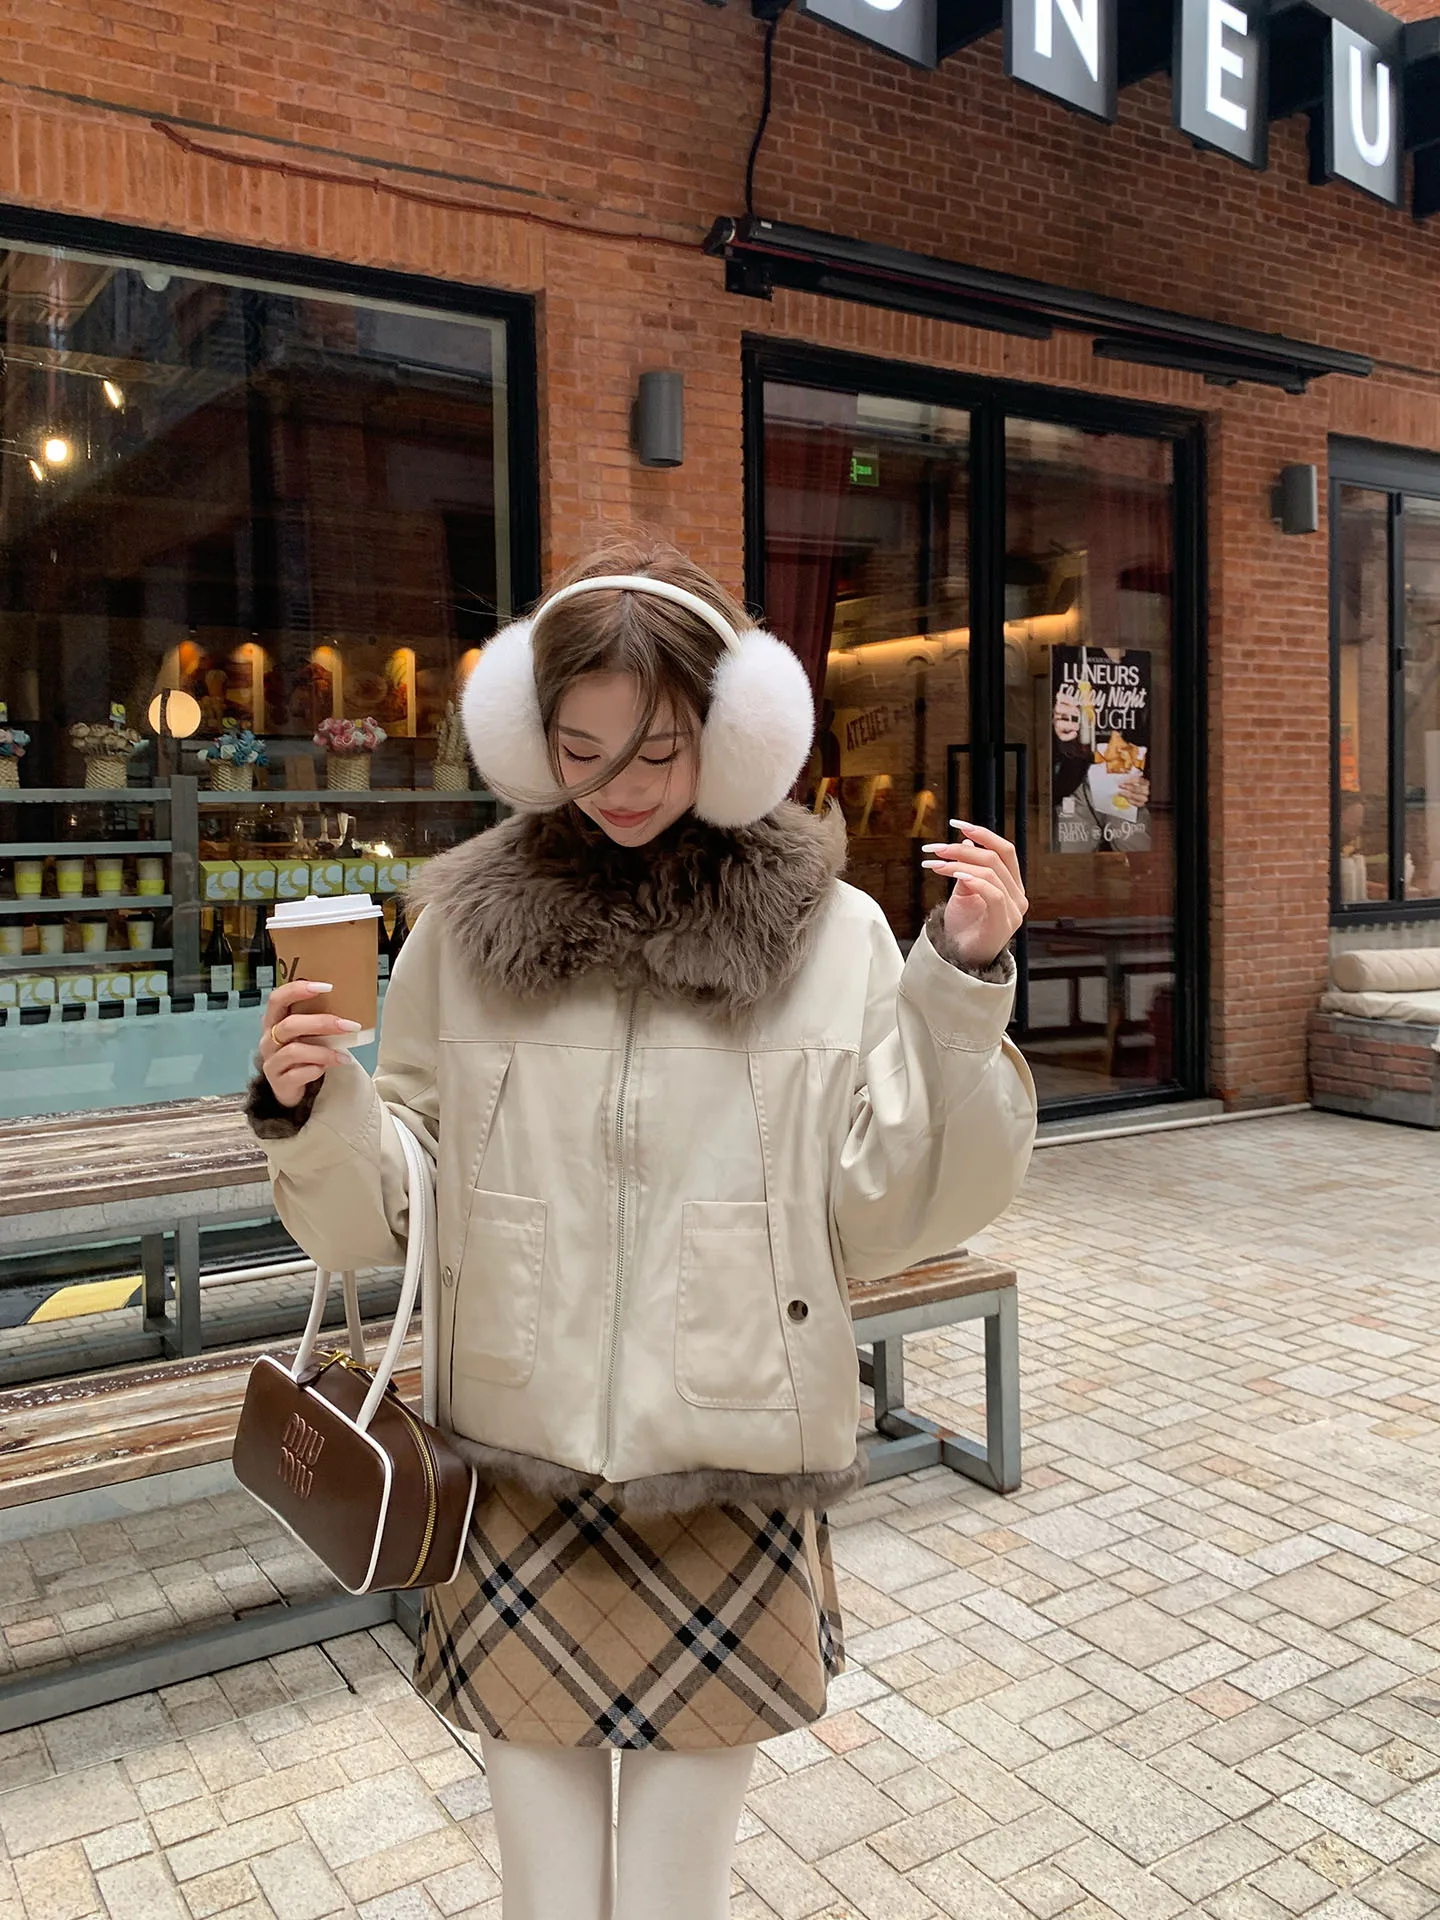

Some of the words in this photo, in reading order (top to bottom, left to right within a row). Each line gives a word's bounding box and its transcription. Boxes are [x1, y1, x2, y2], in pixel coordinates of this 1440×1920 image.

[863, 0, 1391, 167] NEU
[1064, 662, 1140, 686] LUNEURS
[1107, 686, 1147, 713] Night
[283, 1411, 325, 1466] miu
[277, 1447, 313, 1499] miu
